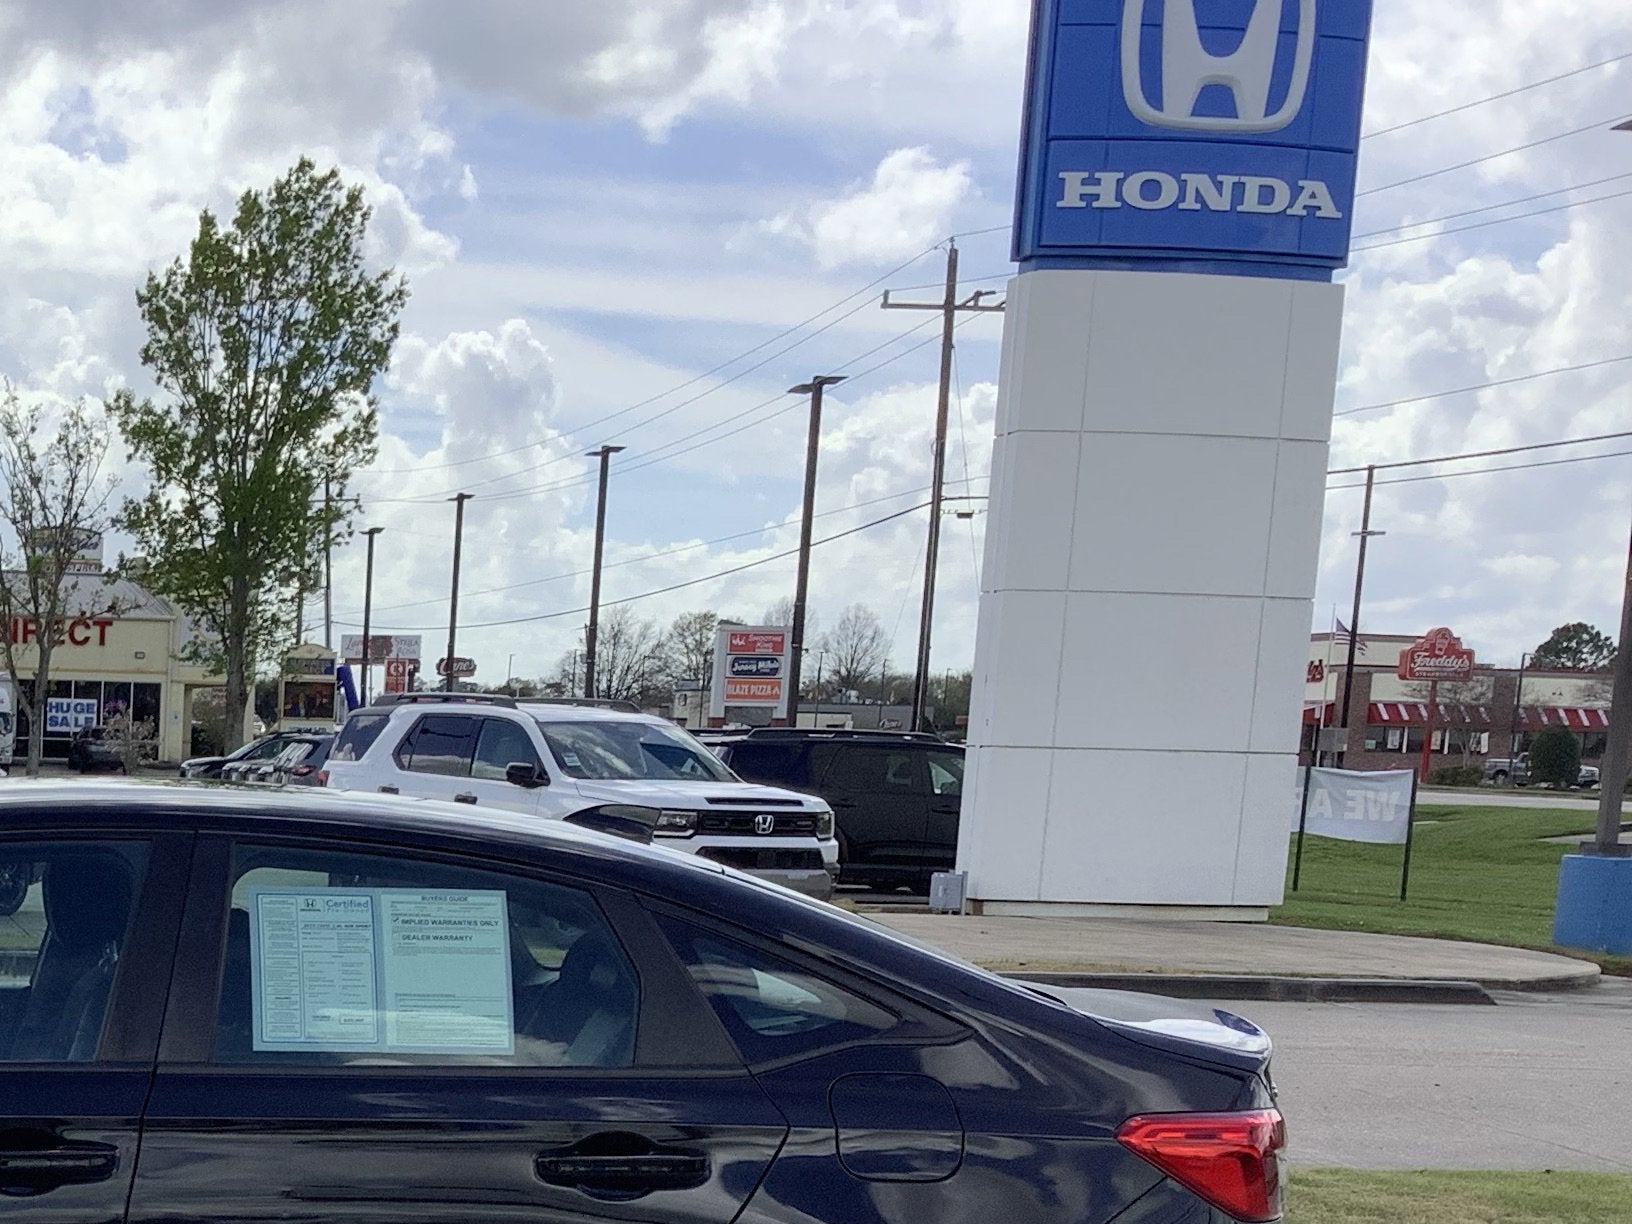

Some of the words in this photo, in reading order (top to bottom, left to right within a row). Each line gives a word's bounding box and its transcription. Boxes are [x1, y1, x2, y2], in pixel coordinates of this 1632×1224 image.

[1055, 170, 1343, 219] HONDA
[1411, 651, 1470, 668] Freddy's
[750, 684, 772, 695] PIZZA
[48, 702, 96, 714] HUGE
[48, 715, 95, 728] SALE
[326, 899, 369, 909] Certified
